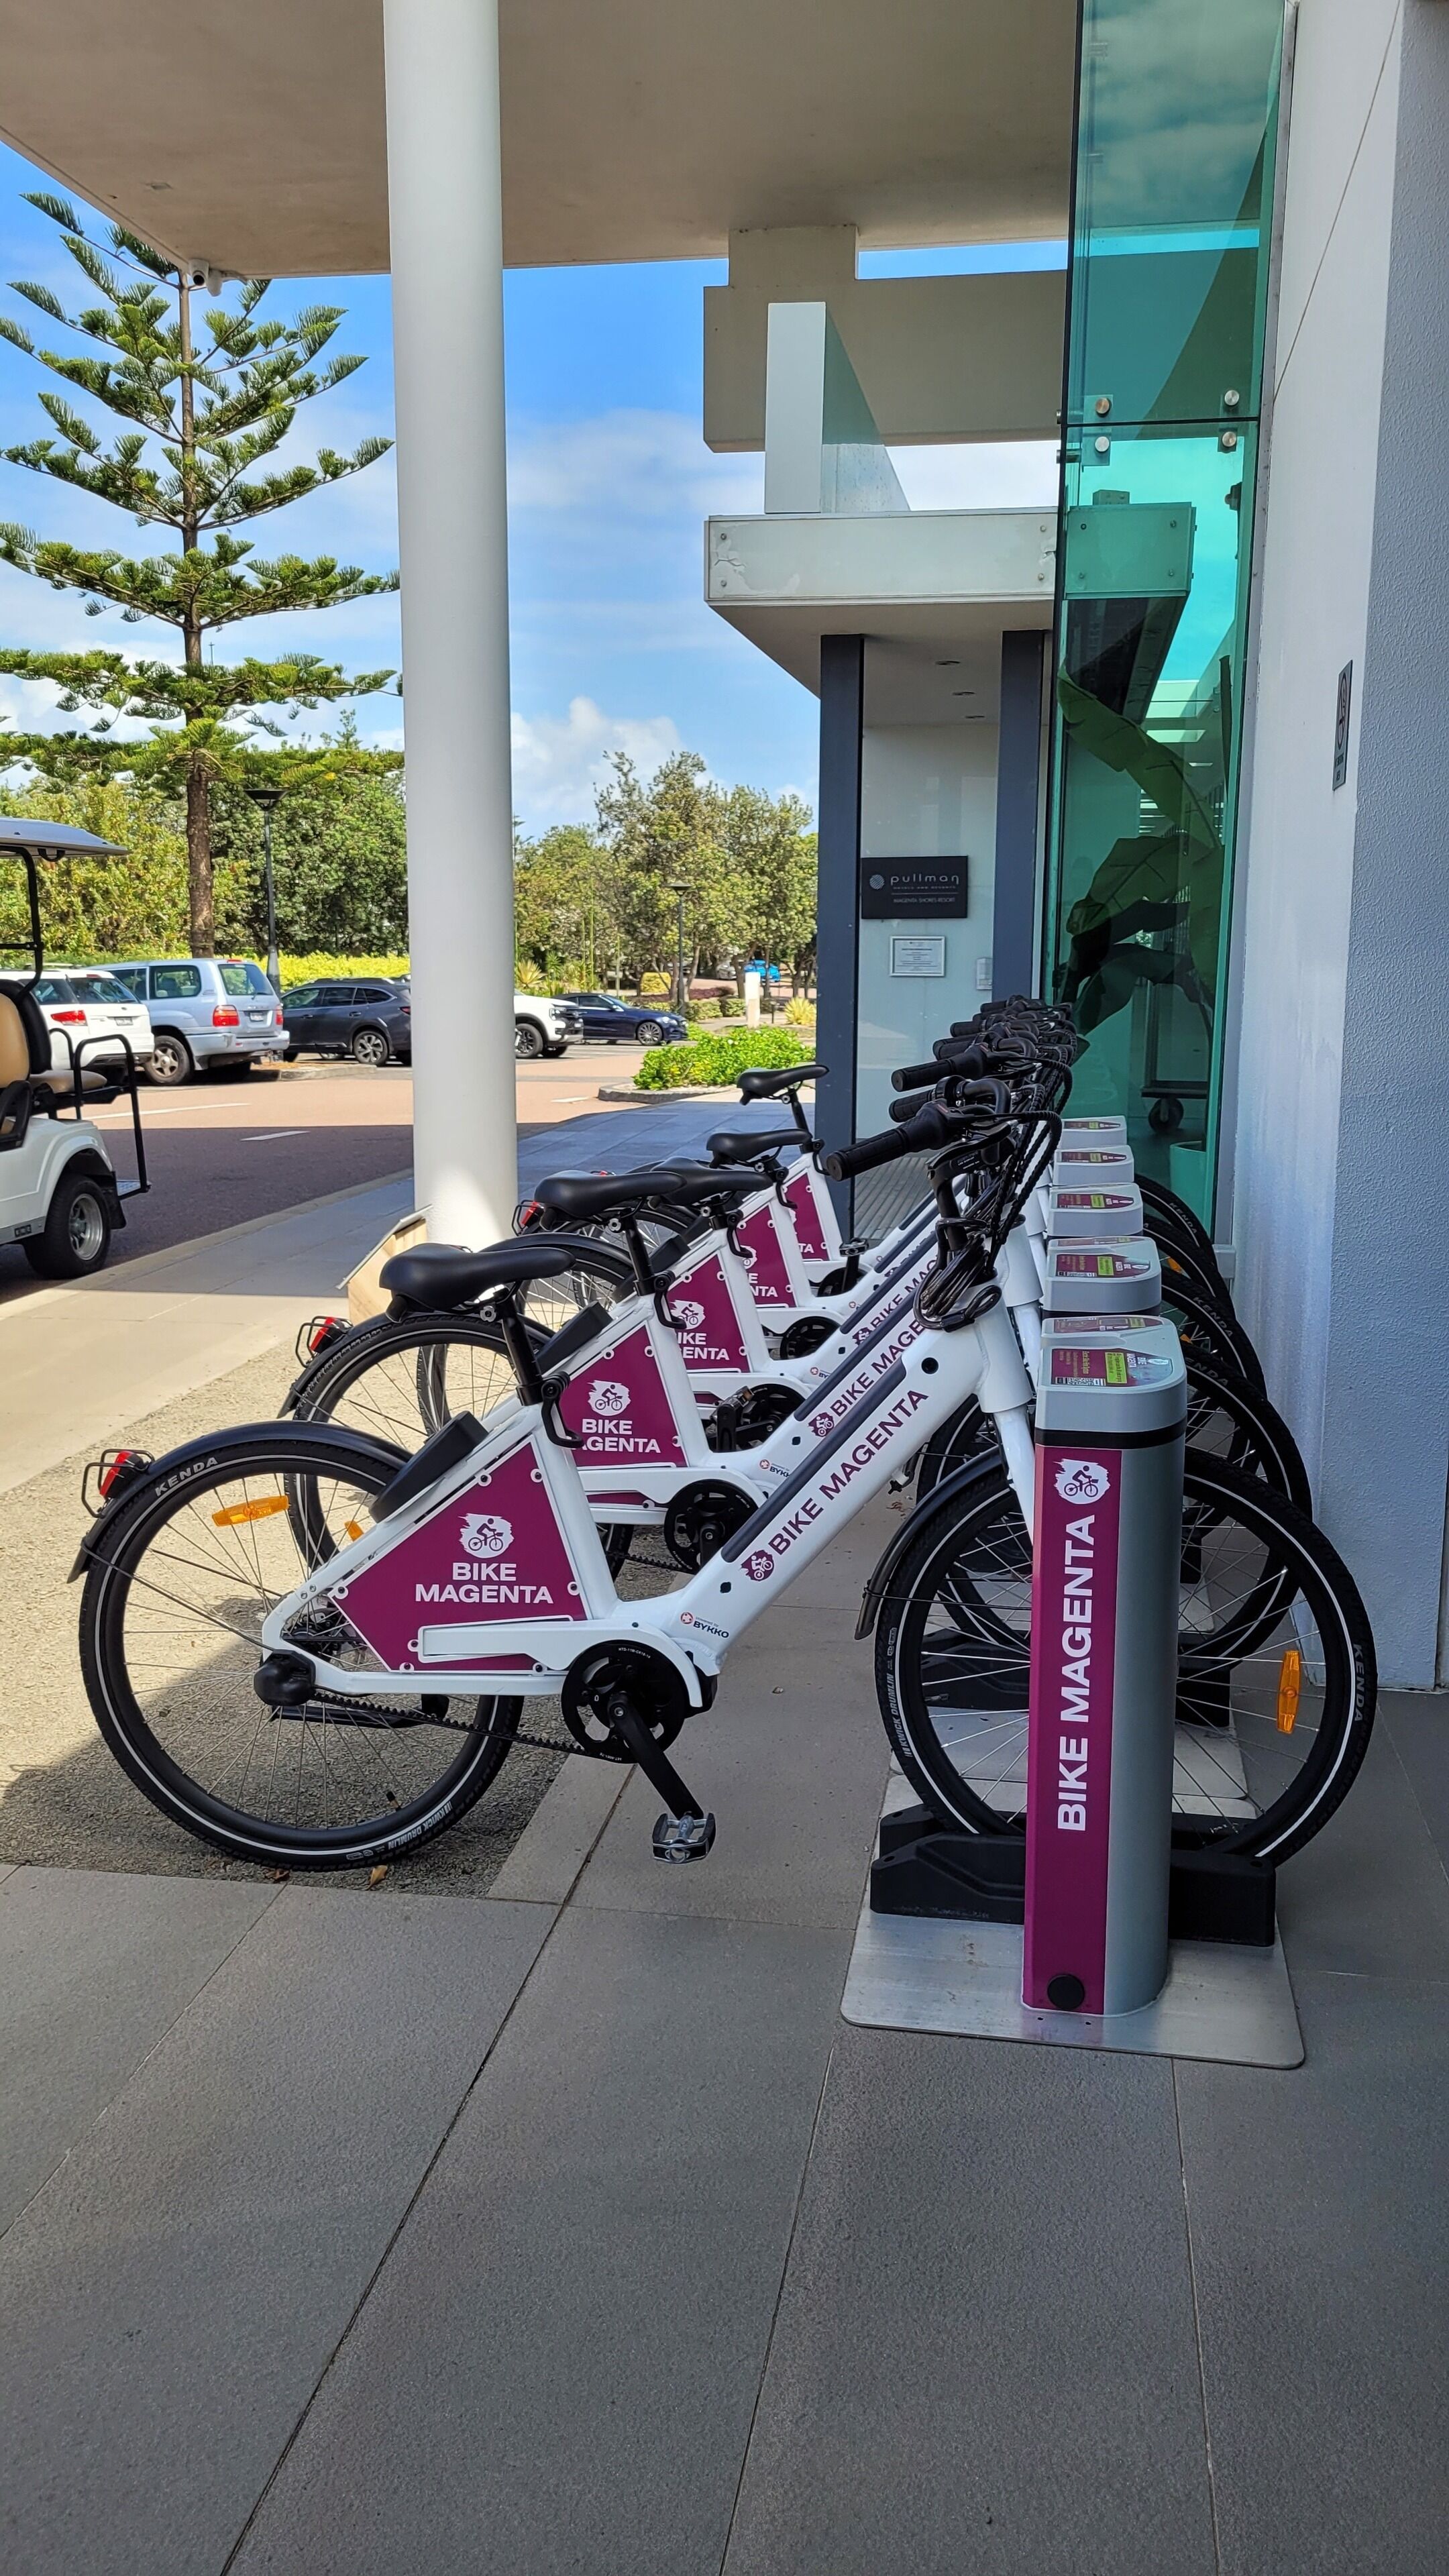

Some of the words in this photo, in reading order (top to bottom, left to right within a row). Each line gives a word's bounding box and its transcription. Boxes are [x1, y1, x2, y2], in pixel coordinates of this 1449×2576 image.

[891, 873, 959, 885] pullman
[1169, 1201, 1197, 1234] KENDA
[1193, 1296, 1233, 1337] KENDA
[678, 1332, 707, 1345] IKE
[682, 1346, 731, 1361] ENTA
[1185, 1357, 1229, 1387] ENDA
[830, 1372, 874, 1417] BIKE
[582, 1418, 633, 1435] BIKE
[572, 1436, 661, 1454] GENTA
[154, 1456, 219, 1497] KENDA
[767, 1497, 824, 1557] BIKE
[818, 1389, 929, 1502] MAGENTA
[452, 1562, 517, 1582] BIKE
[415, 1583, 554, 1604] MAGENTA
[693, 1620, 729, 1638] BYKKO
[1061, 1514, 1095, 1725] MAGENTA
[887, 1673, 899, 1715] DRUMLIN
[1352, 1642, 1364, 1723] KENDA
[894, 1717, 908, 1747] KWICK
[1057, 1736, 1088, 1833] BIKE
[423, 1810, 445, 1831] KWICK
[388, 1825, 423, 1850] DRUMLIN
